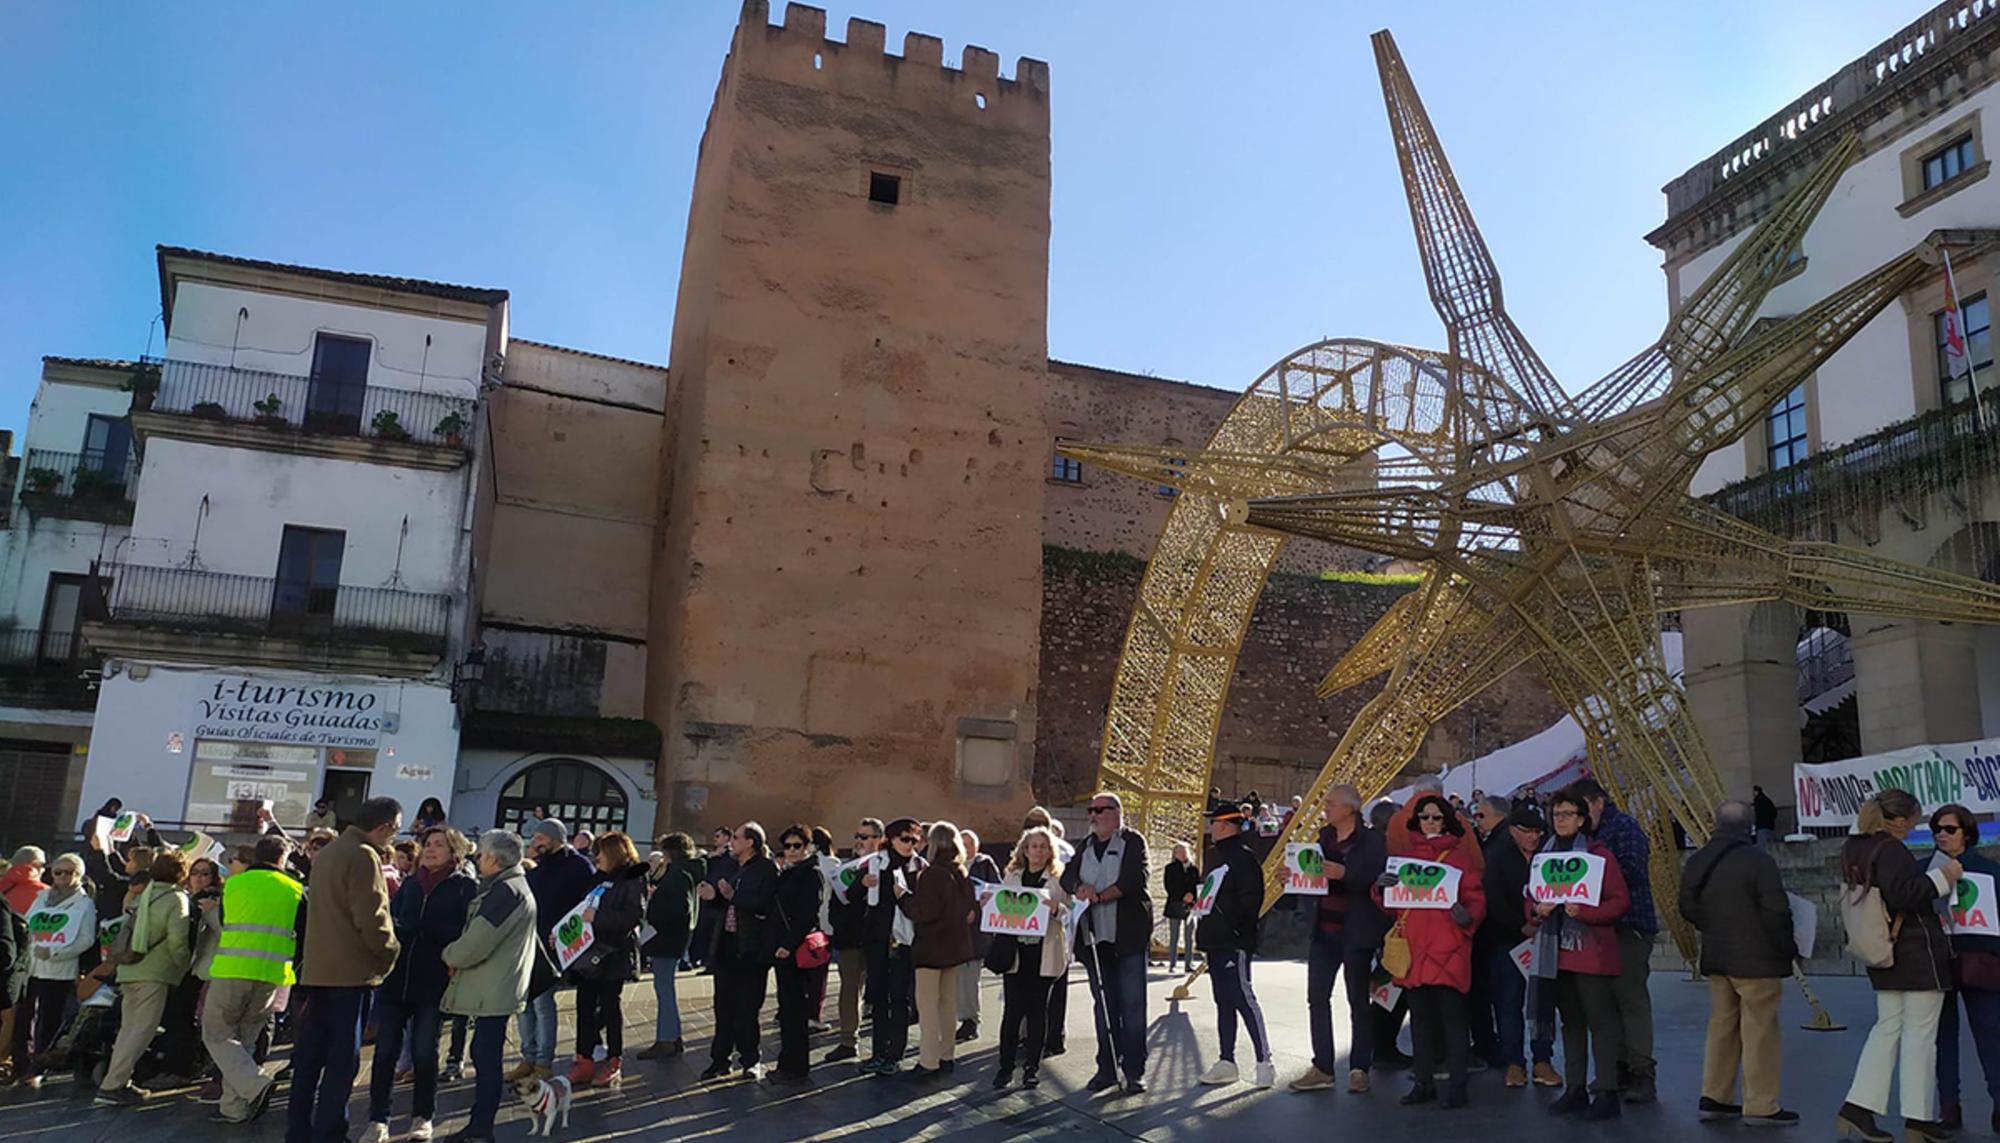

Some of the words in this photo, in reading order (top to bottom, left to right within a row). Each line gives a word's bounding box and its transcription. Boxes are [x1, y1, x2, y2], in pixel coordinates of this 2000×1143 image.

[214, 679, 376, 711] i-turismo
[200, 699, 282, 724] Visitas
[285, 708, 382, 731] Guiadas
[237, 725, 298, 742] Oficiales
[299, 730, 315, 743] de
[318, 732, 376, 746] Turismo
[400, 766, 432, 778] Agua
[1799, 776, 1822, 817] NO
[1407, 862, 1440, 877] NO
[1550, 857, 1581, 874] NO
[1004, 889, 1033, 905] NO
[1392, 885, 1449, 903] MINA
[1536, 882, 1589, 899] MINA
[36, 911, 63, 923] NO
[561, 914, 579, 937] NO
[989, 913, 1039, 930] MINA
[562, 929, 592, 962] MINA
